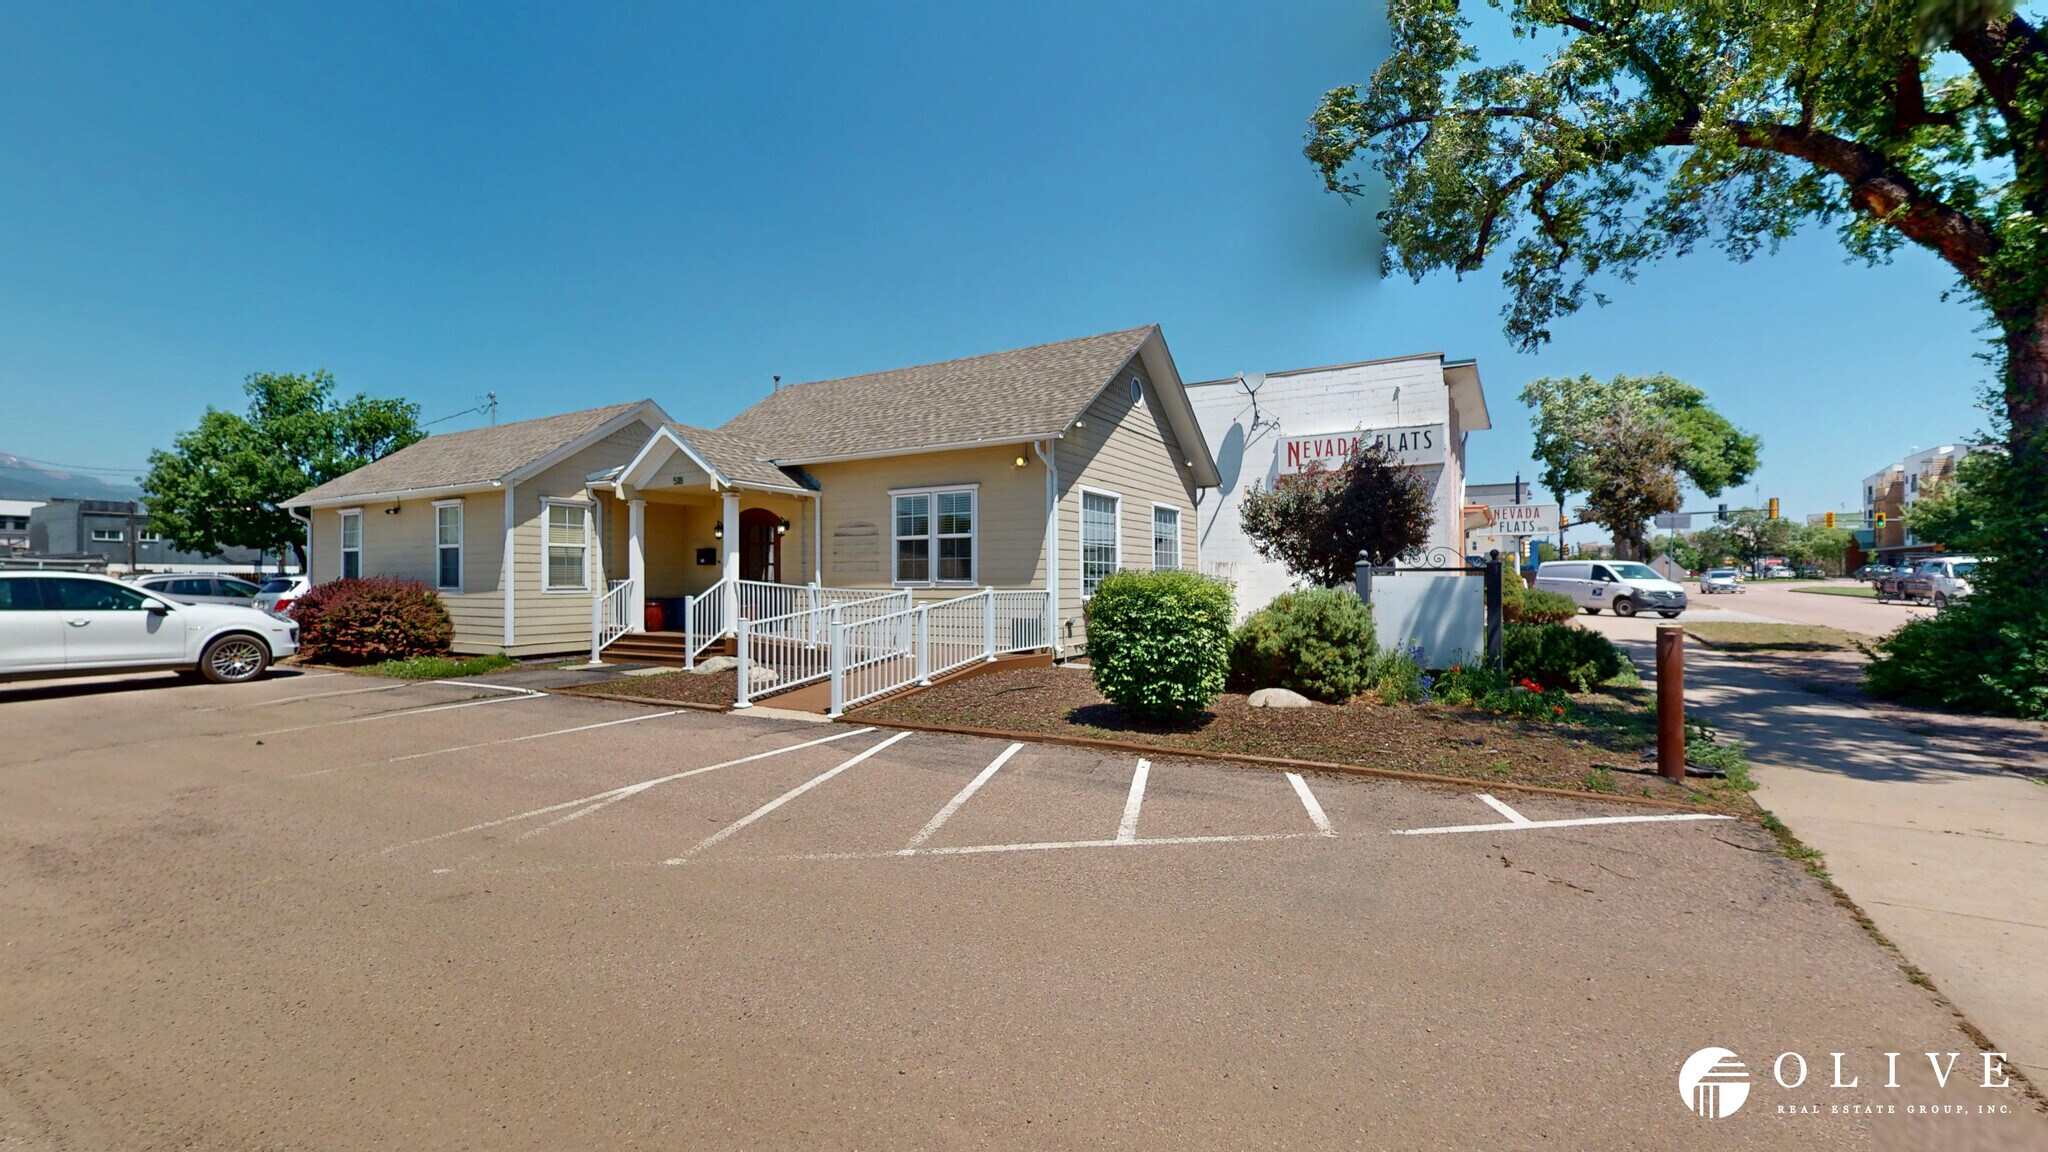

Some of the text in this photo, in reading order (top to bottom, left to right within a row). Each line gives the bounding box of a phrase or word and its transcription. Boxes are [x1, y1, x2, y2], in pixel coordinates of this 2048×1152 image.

[1287, 436, 1359, 468] NEVADA
[672, 476, 684, 485] 518
[1493, 507, 1540, 520] NEVADA
[1499, 520, 1535, 533] FLATS
